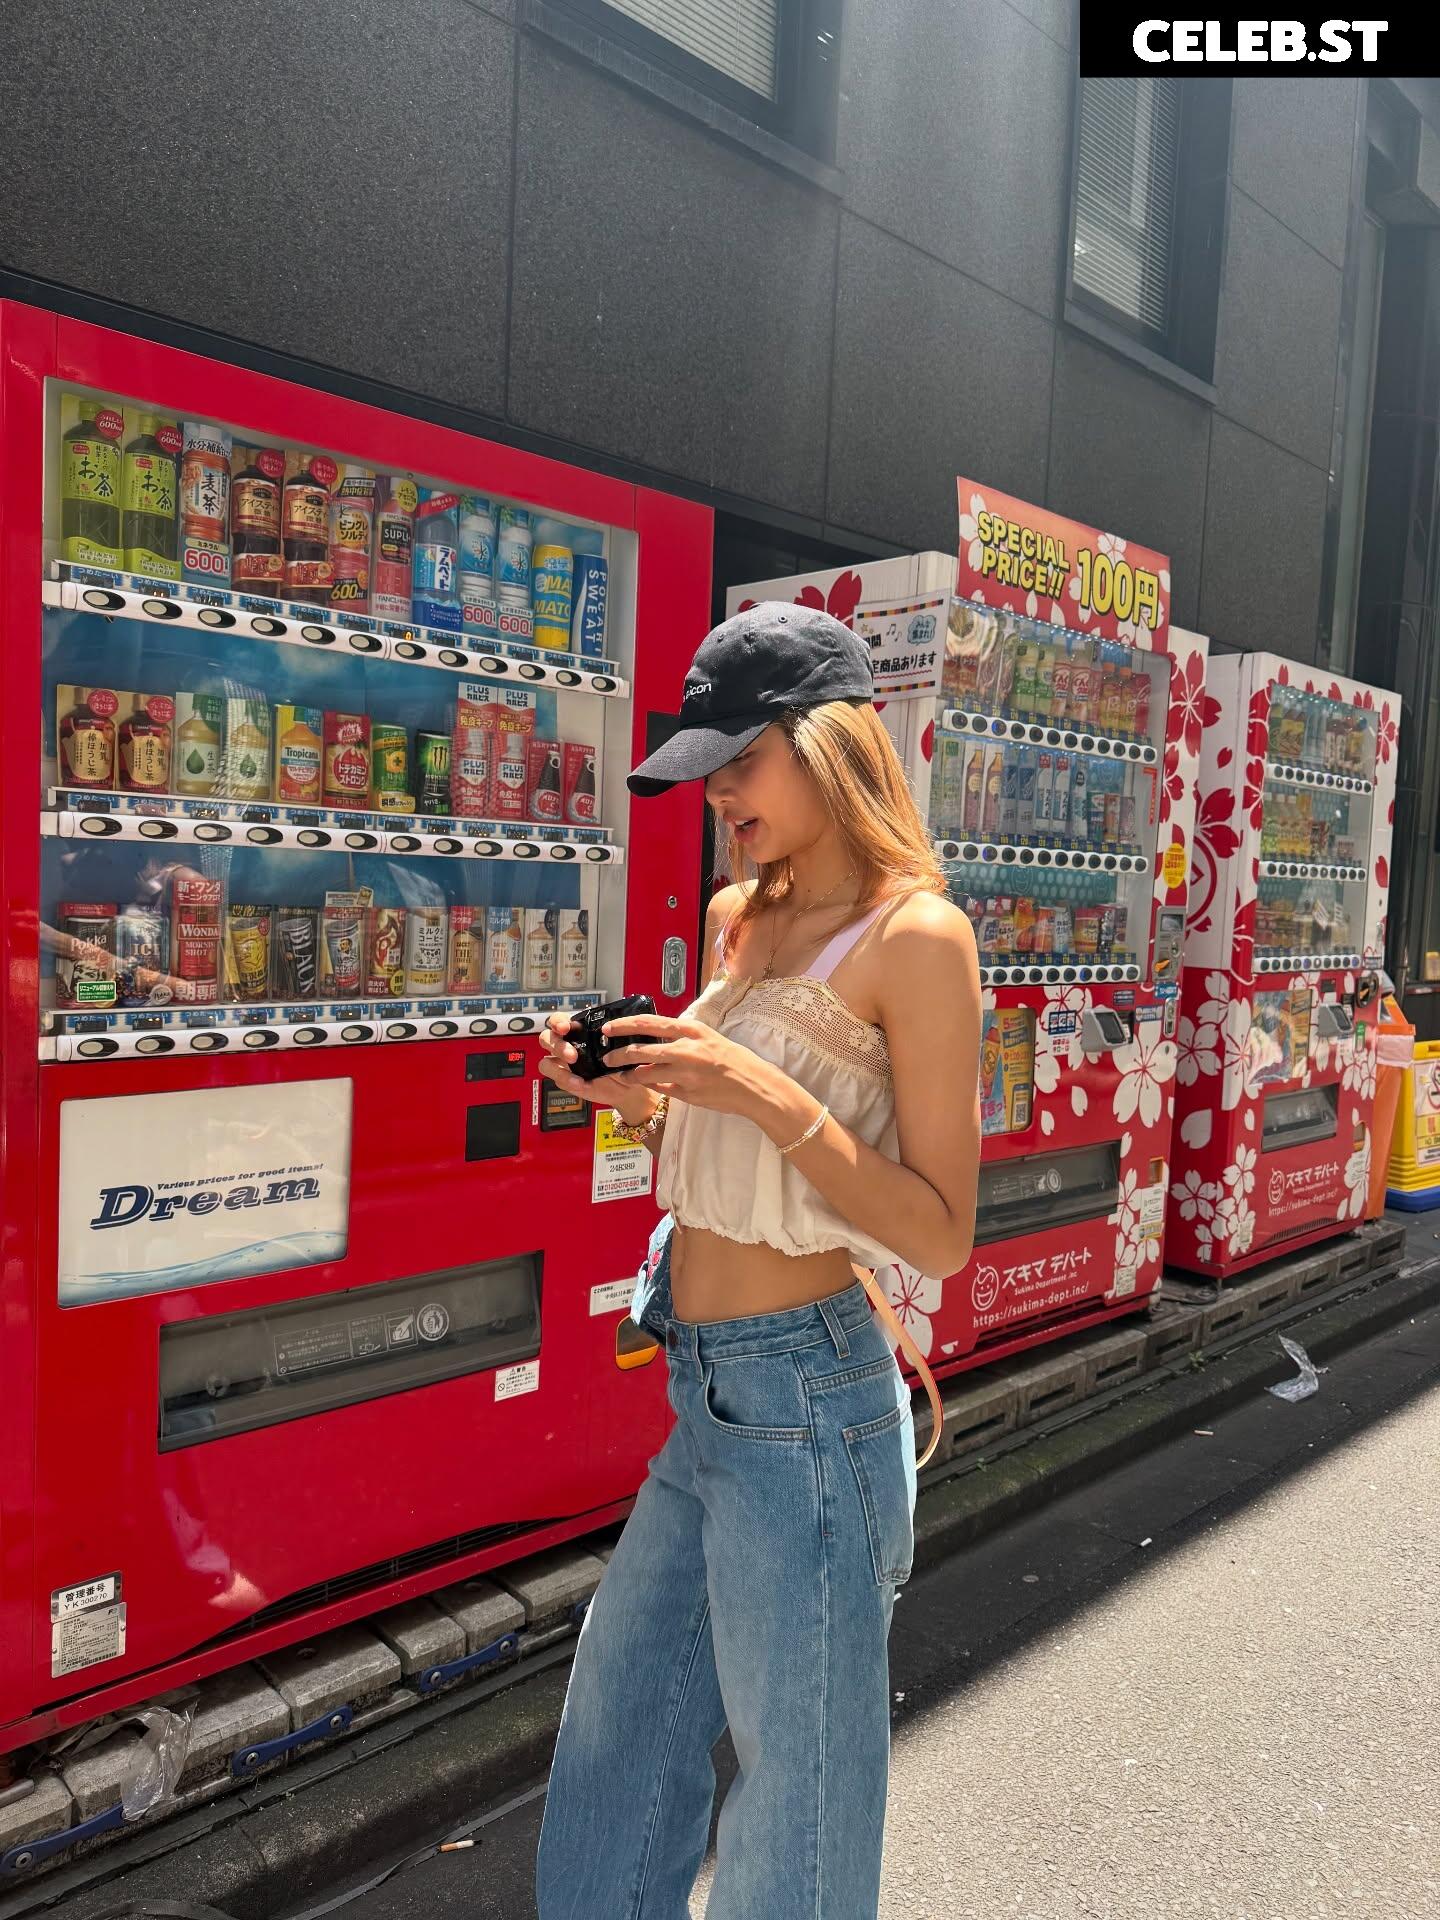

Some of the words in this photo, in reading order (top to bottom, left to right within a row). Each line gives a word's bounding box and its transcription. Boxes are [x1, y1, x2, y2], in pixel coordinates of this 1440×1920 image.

[78, 456, 114, 497] お茶
[141, 470, 172, 510] お茶
[201, 473, 219, 515] 麦茶
[978, 511, 1070, 571] SPECIAL
[982, 546, 1065, 599] PRICE!!
[1078, 548, 1160, 630] 100円
[586, 570, 599, 644] SWEAT
[467, 685, 489, 695] PLUS
[467, 693, 490, 702] カルピス
[506, 690, 528, 700] PLUS
[506, 699, 528, 707] カルピス
[286, 747, 319, 759] Tropicana
[463, 759, 485, 769] PLUS
[503, 764, 524, 773] PLUS
[71, 935, 107, 951] Pokka
[181, 925, 218, 936] WONDA
[289, 929, 315, 993] BLACK
[175, 981, 217, 1001] 朝専用
[157, 1179, 195, 1190] Various
[196, 1175, 235, 1187] prices
[238, 1171, 255, 1180] for
[258, 1167, 285, 1178] good
[1286, 1167, 1312, 1189] スキマ
[1314, 1161, 1339, 1180] デパート
[90, 1176, 320, 1230] Dream
[1002, 1258, 1048, 1289] スキマ
[1051, 1247, 1092, 1274] デパート
[973, 1282, 1089, 1328] https://sukima-dept.inc/
[65, 1582, 106, 1603] 管理番号
